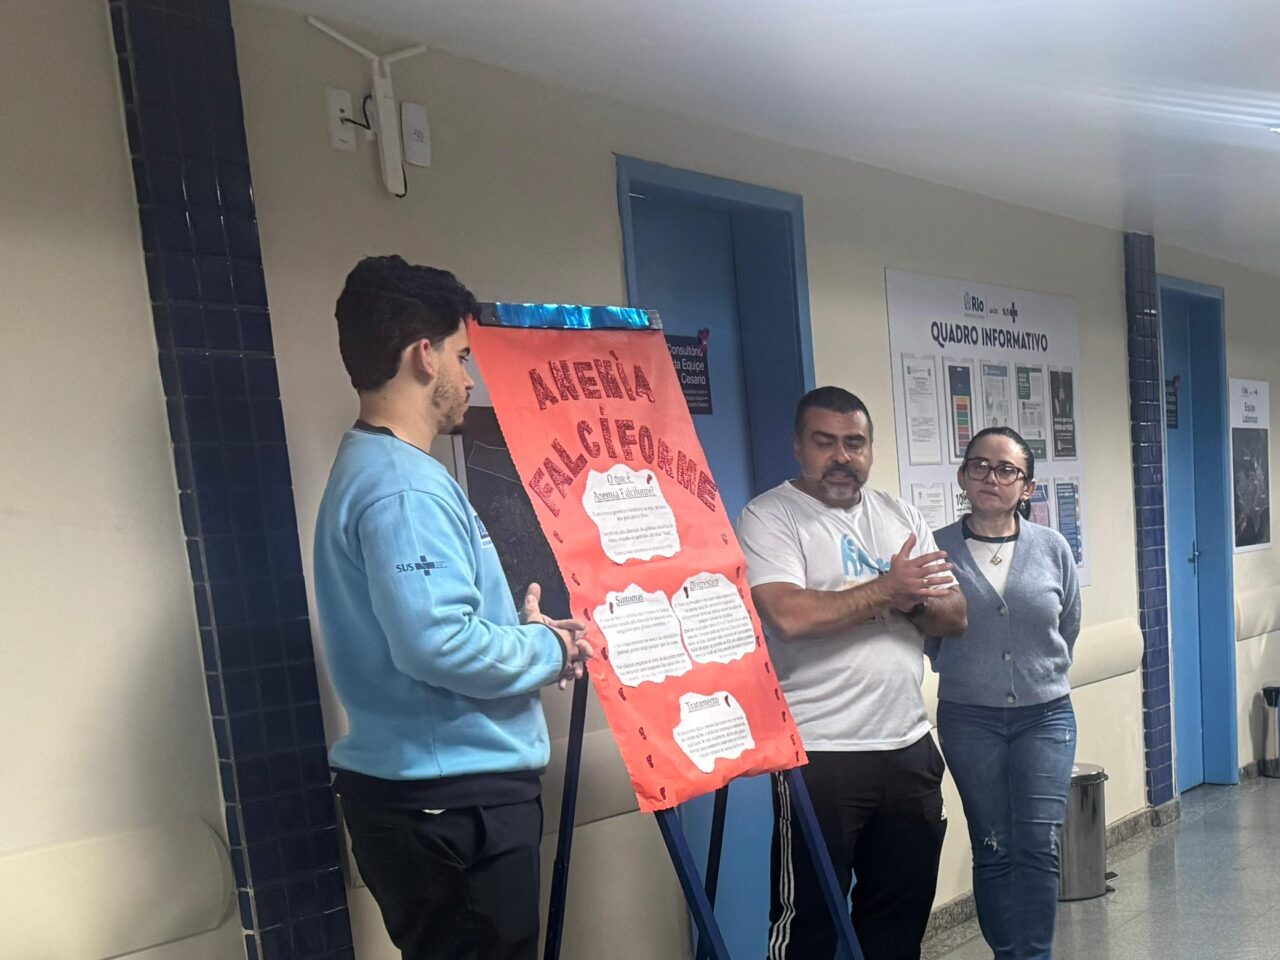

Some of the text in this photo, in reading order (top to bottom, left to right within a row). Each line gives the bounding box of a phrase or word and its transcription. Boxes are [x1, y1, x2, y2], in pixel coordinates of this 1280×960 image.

[971, 295, 985, 312] Rio
[930, 320, 1049, 353] QUADRO INFORMATIVO
[682, 358, 705, 373] Equipe
[607, 473, 613, 484] O
[396, 562, 414, 573] SUS
[615, 593, 644, 606] Sintomas
